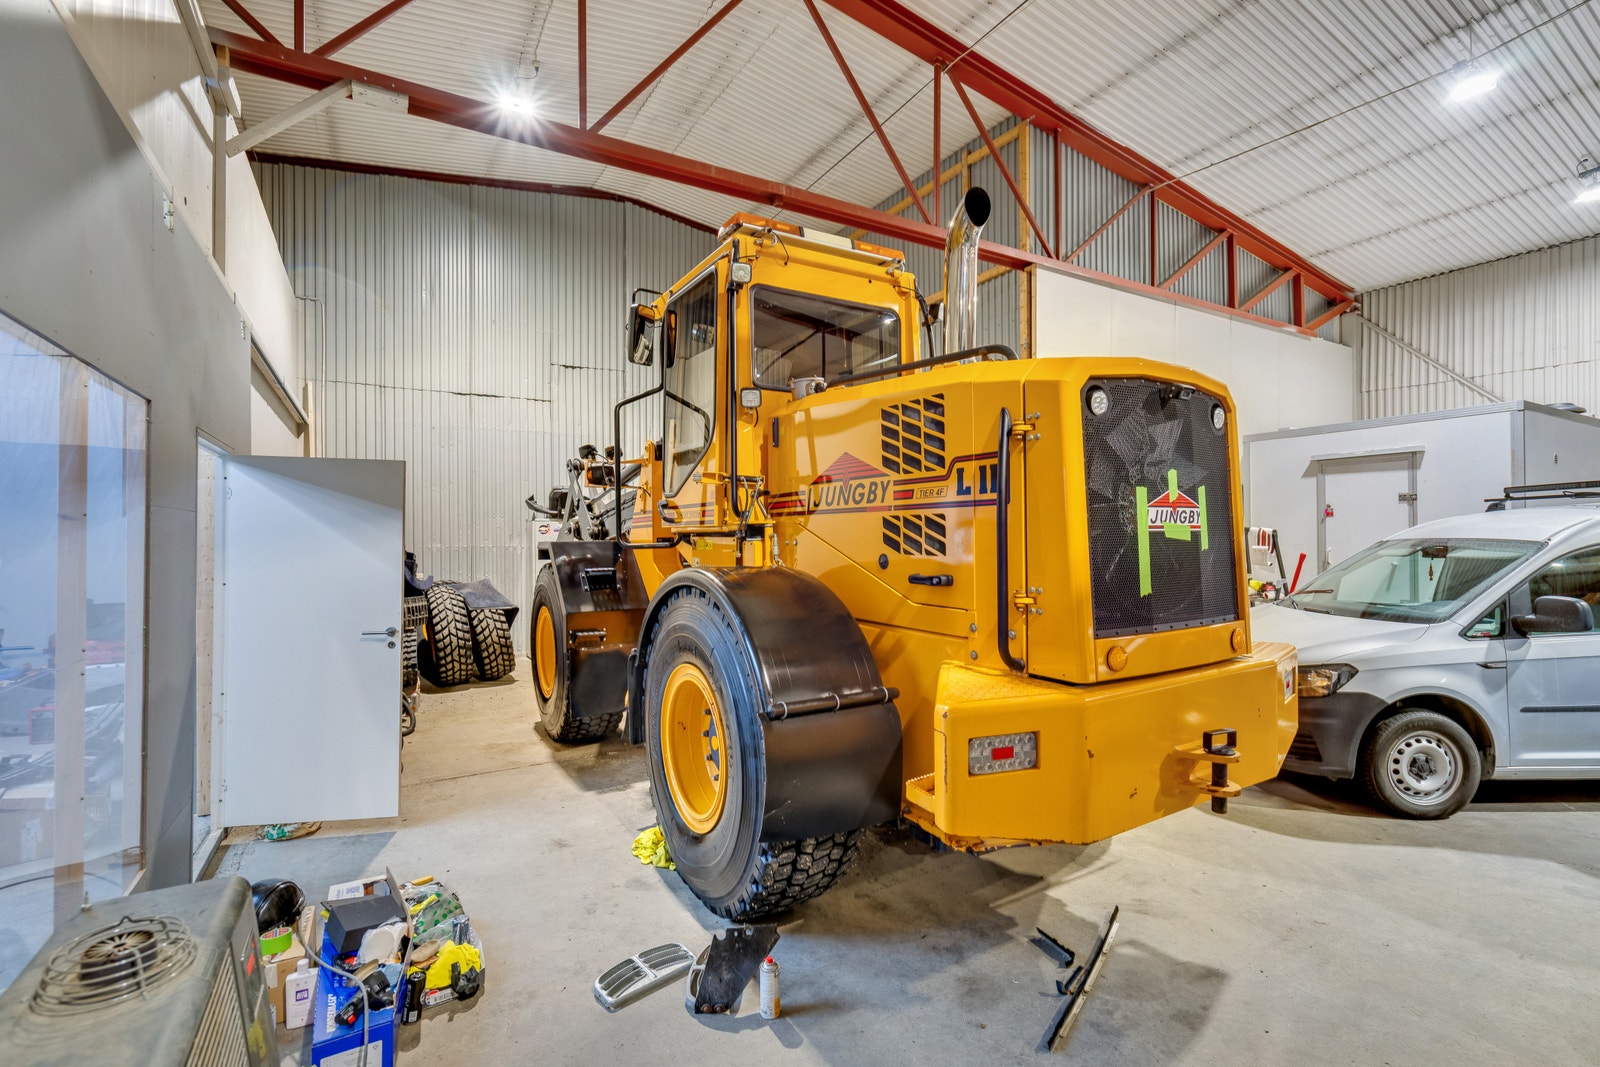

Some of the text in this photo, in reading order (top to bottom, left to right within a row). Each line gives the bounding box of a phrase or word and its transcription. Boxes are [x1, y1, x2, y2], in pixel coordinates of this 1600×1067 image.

[956, 467, 972, 496] L
[920, 489, 935, 498] TIER
[1148, 509, 1201, 524] JUNGBY
